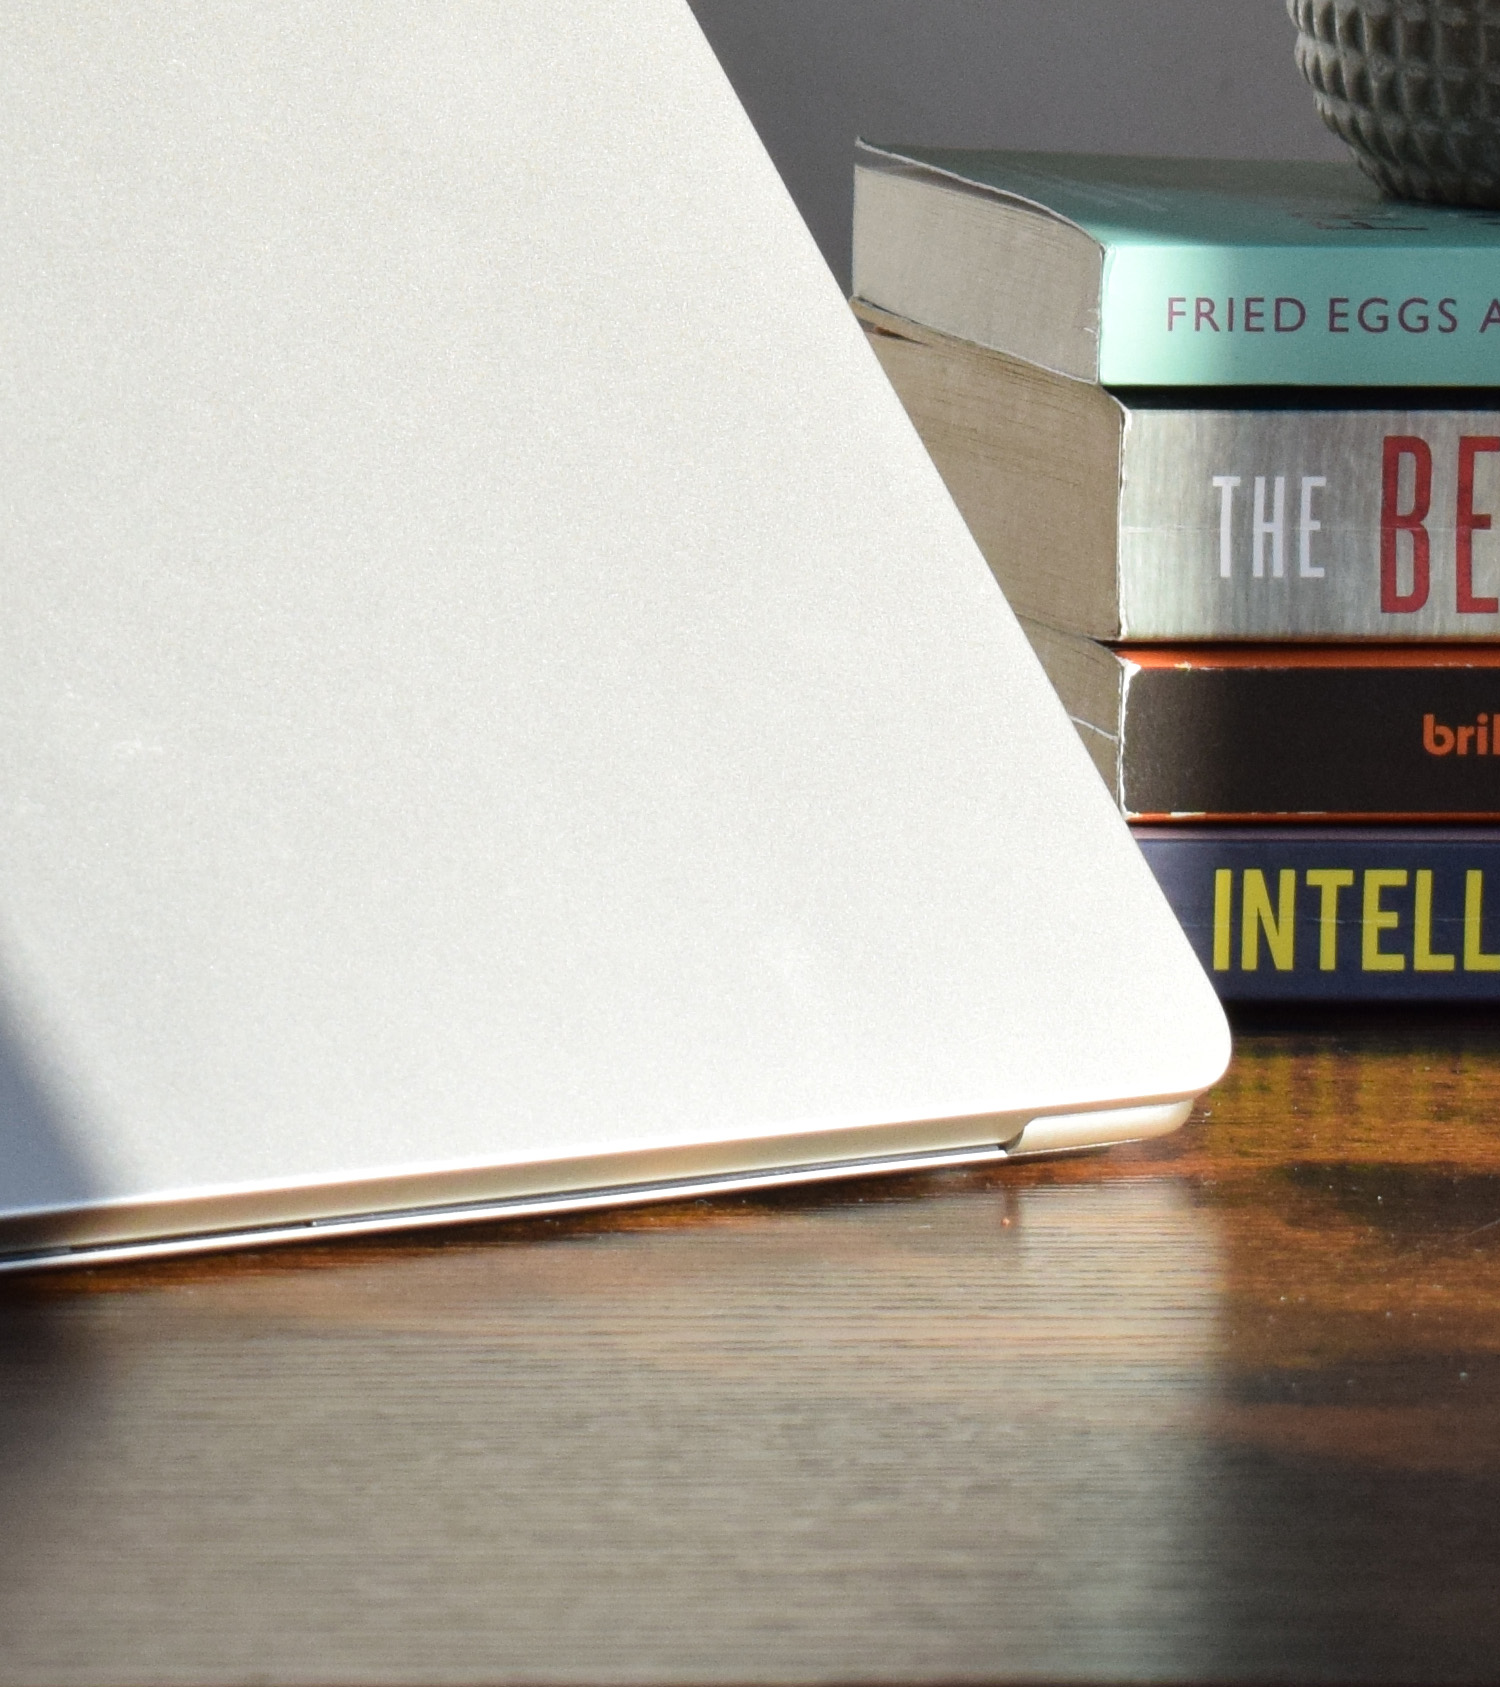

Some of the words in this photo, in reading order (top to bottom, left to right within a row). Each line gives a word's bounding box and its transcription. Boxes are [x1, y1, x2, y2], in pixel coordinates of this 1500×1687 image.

[1165, 296, 1307, 333] FRIED
[1327, 296, 1460, 334] EGGS
[1211, 475, 1327, 579] THE
